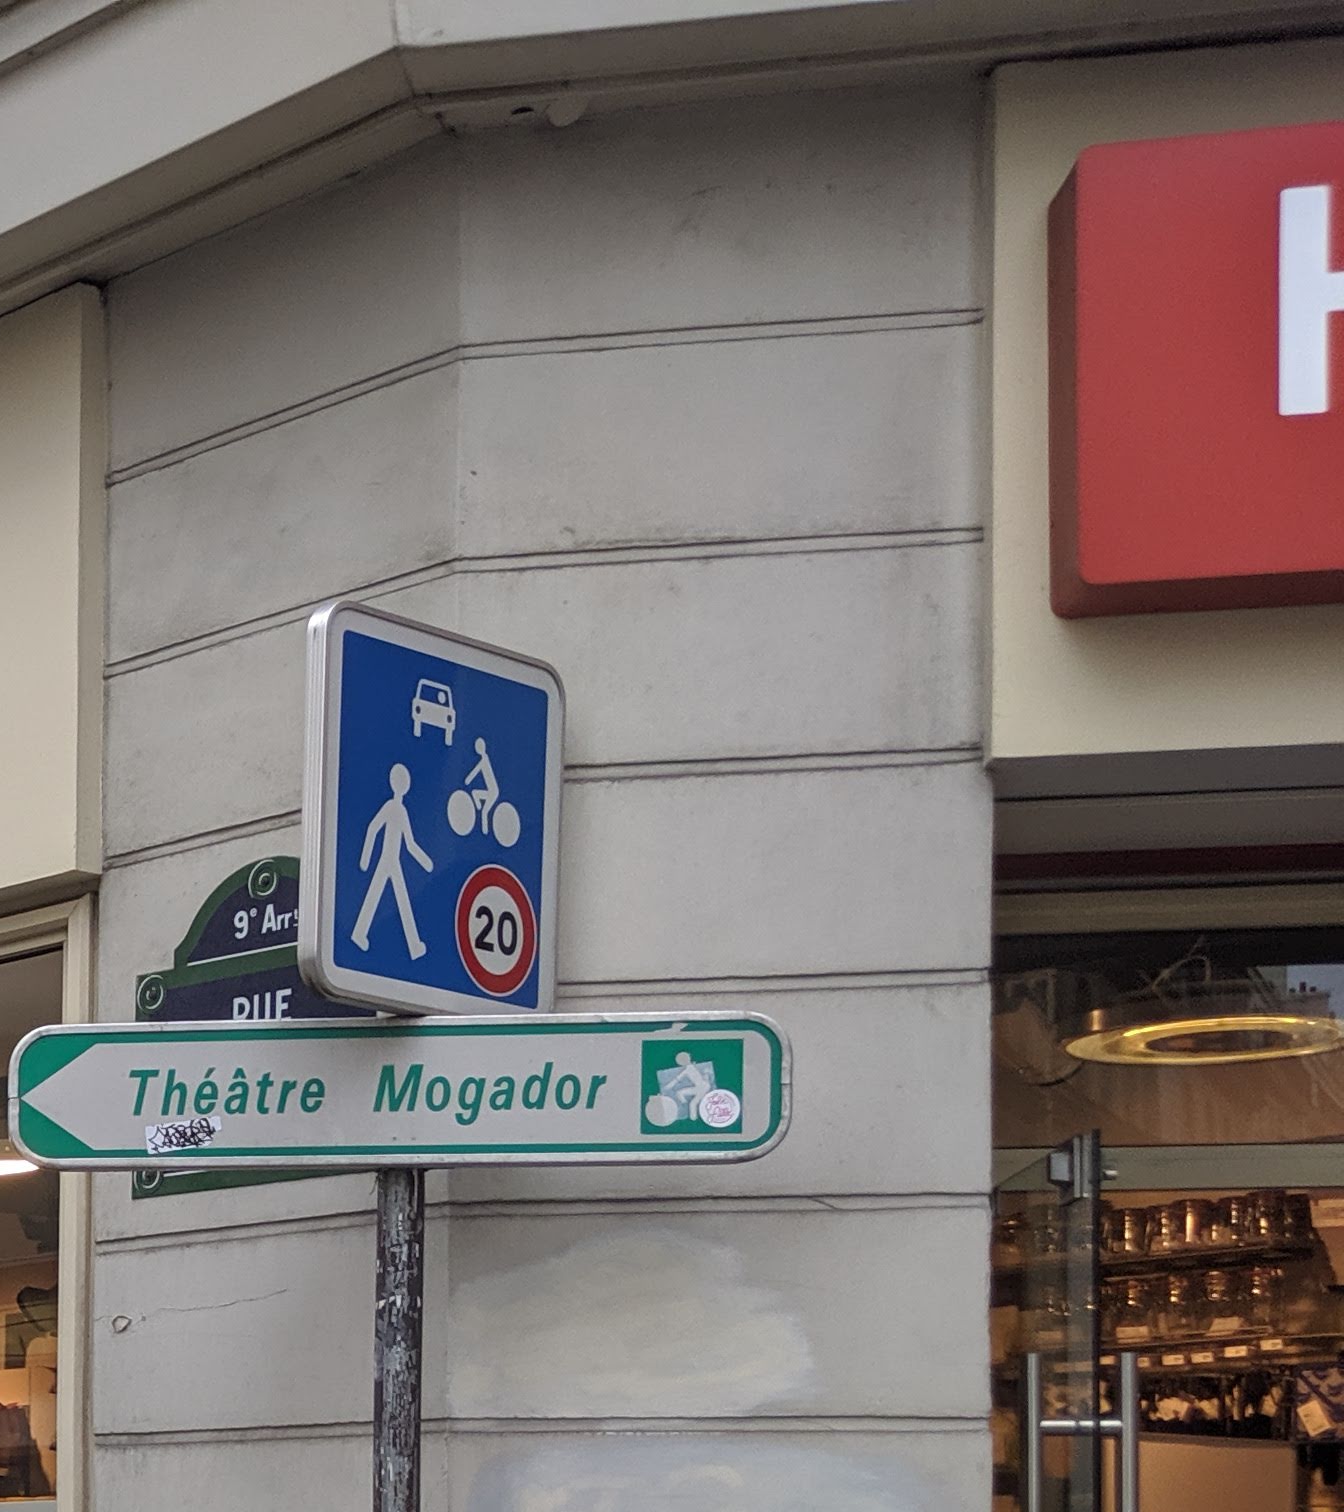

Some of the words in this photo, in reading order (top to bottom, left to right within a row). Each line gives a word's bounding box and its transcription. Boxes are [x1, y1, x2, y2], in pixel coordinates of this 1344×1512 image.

[474, 906, 518, 957] 20
[128, 1067, 326, 1118] Théâtre
[373, 1062, 608, 1126] Mogador
